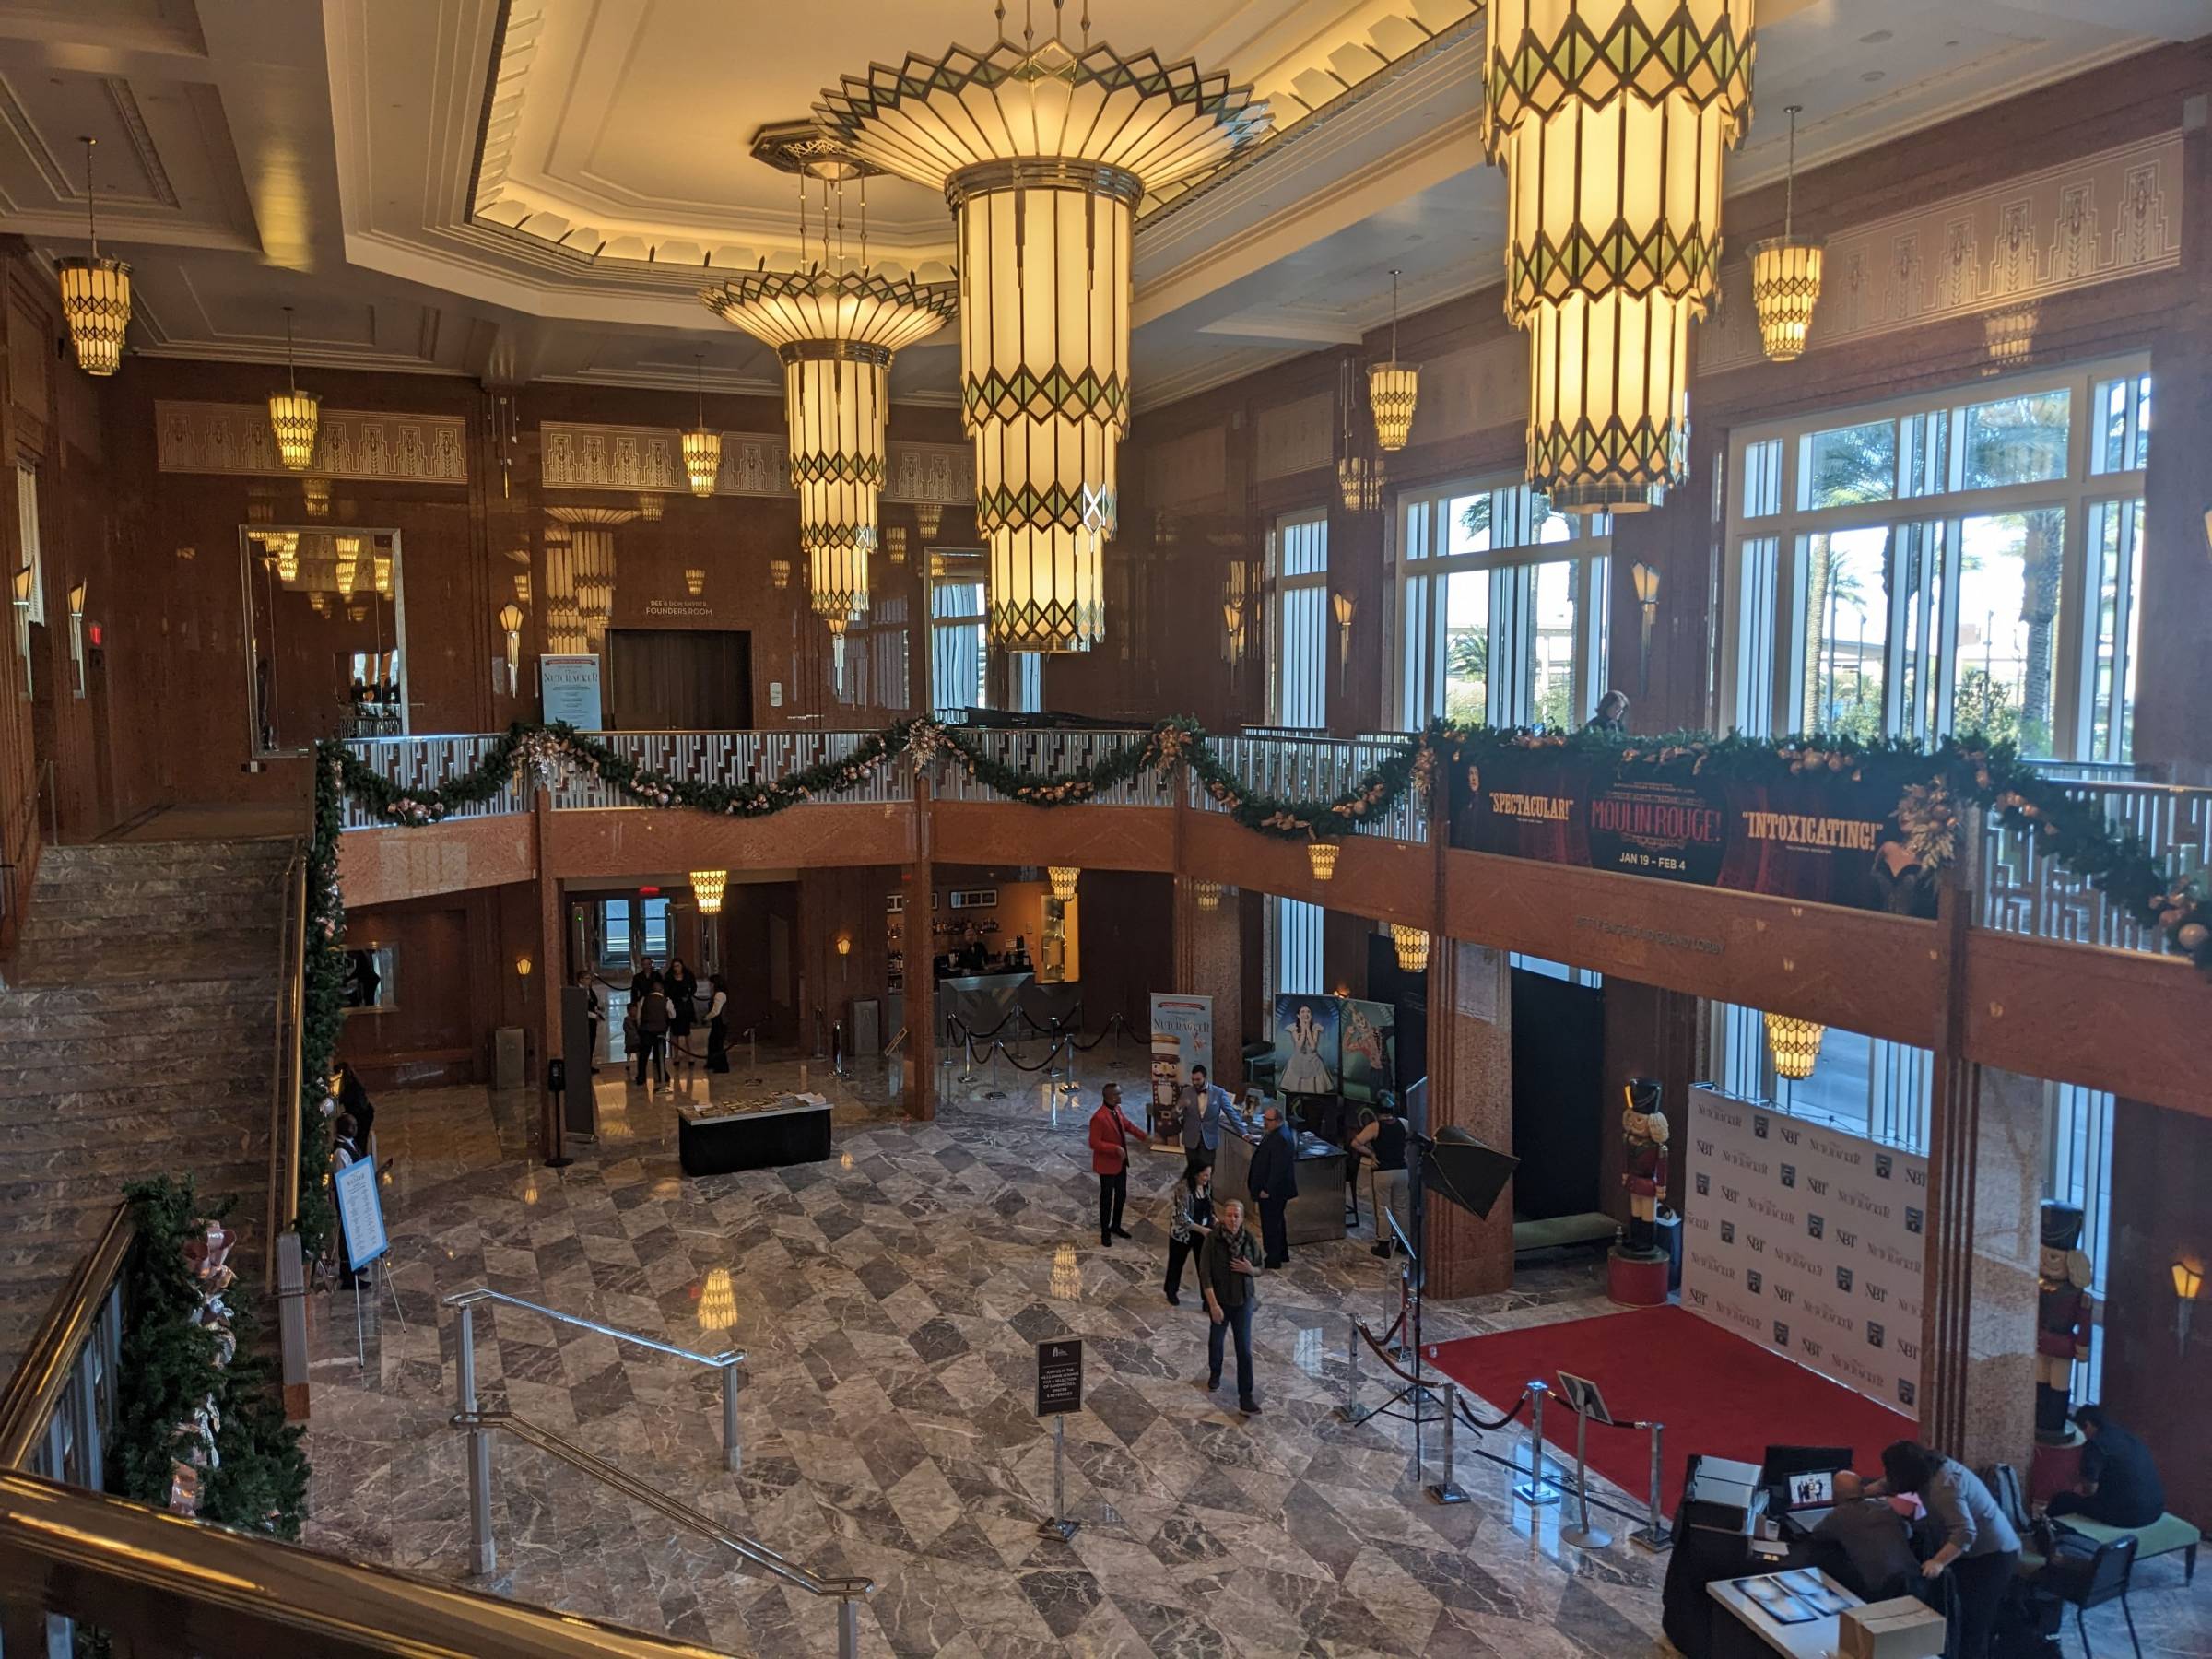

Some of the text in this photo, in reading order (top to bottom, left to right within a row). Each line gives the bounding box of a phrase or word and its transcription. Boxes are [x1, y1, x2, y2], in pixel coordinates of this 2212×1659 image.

[645, 606, 713, 616] FOUNDERS ROOM
[1591, 799, 1652, 833] MOULIN
[1654, 805, 1722, 842] ROUGE!
[1619, 852, 1637, 865] JAN
[1640, 854, 1649, 865] 19
[1658, 857, 1677, 869] FEB
[1678, 860, 1686, 870] 4
